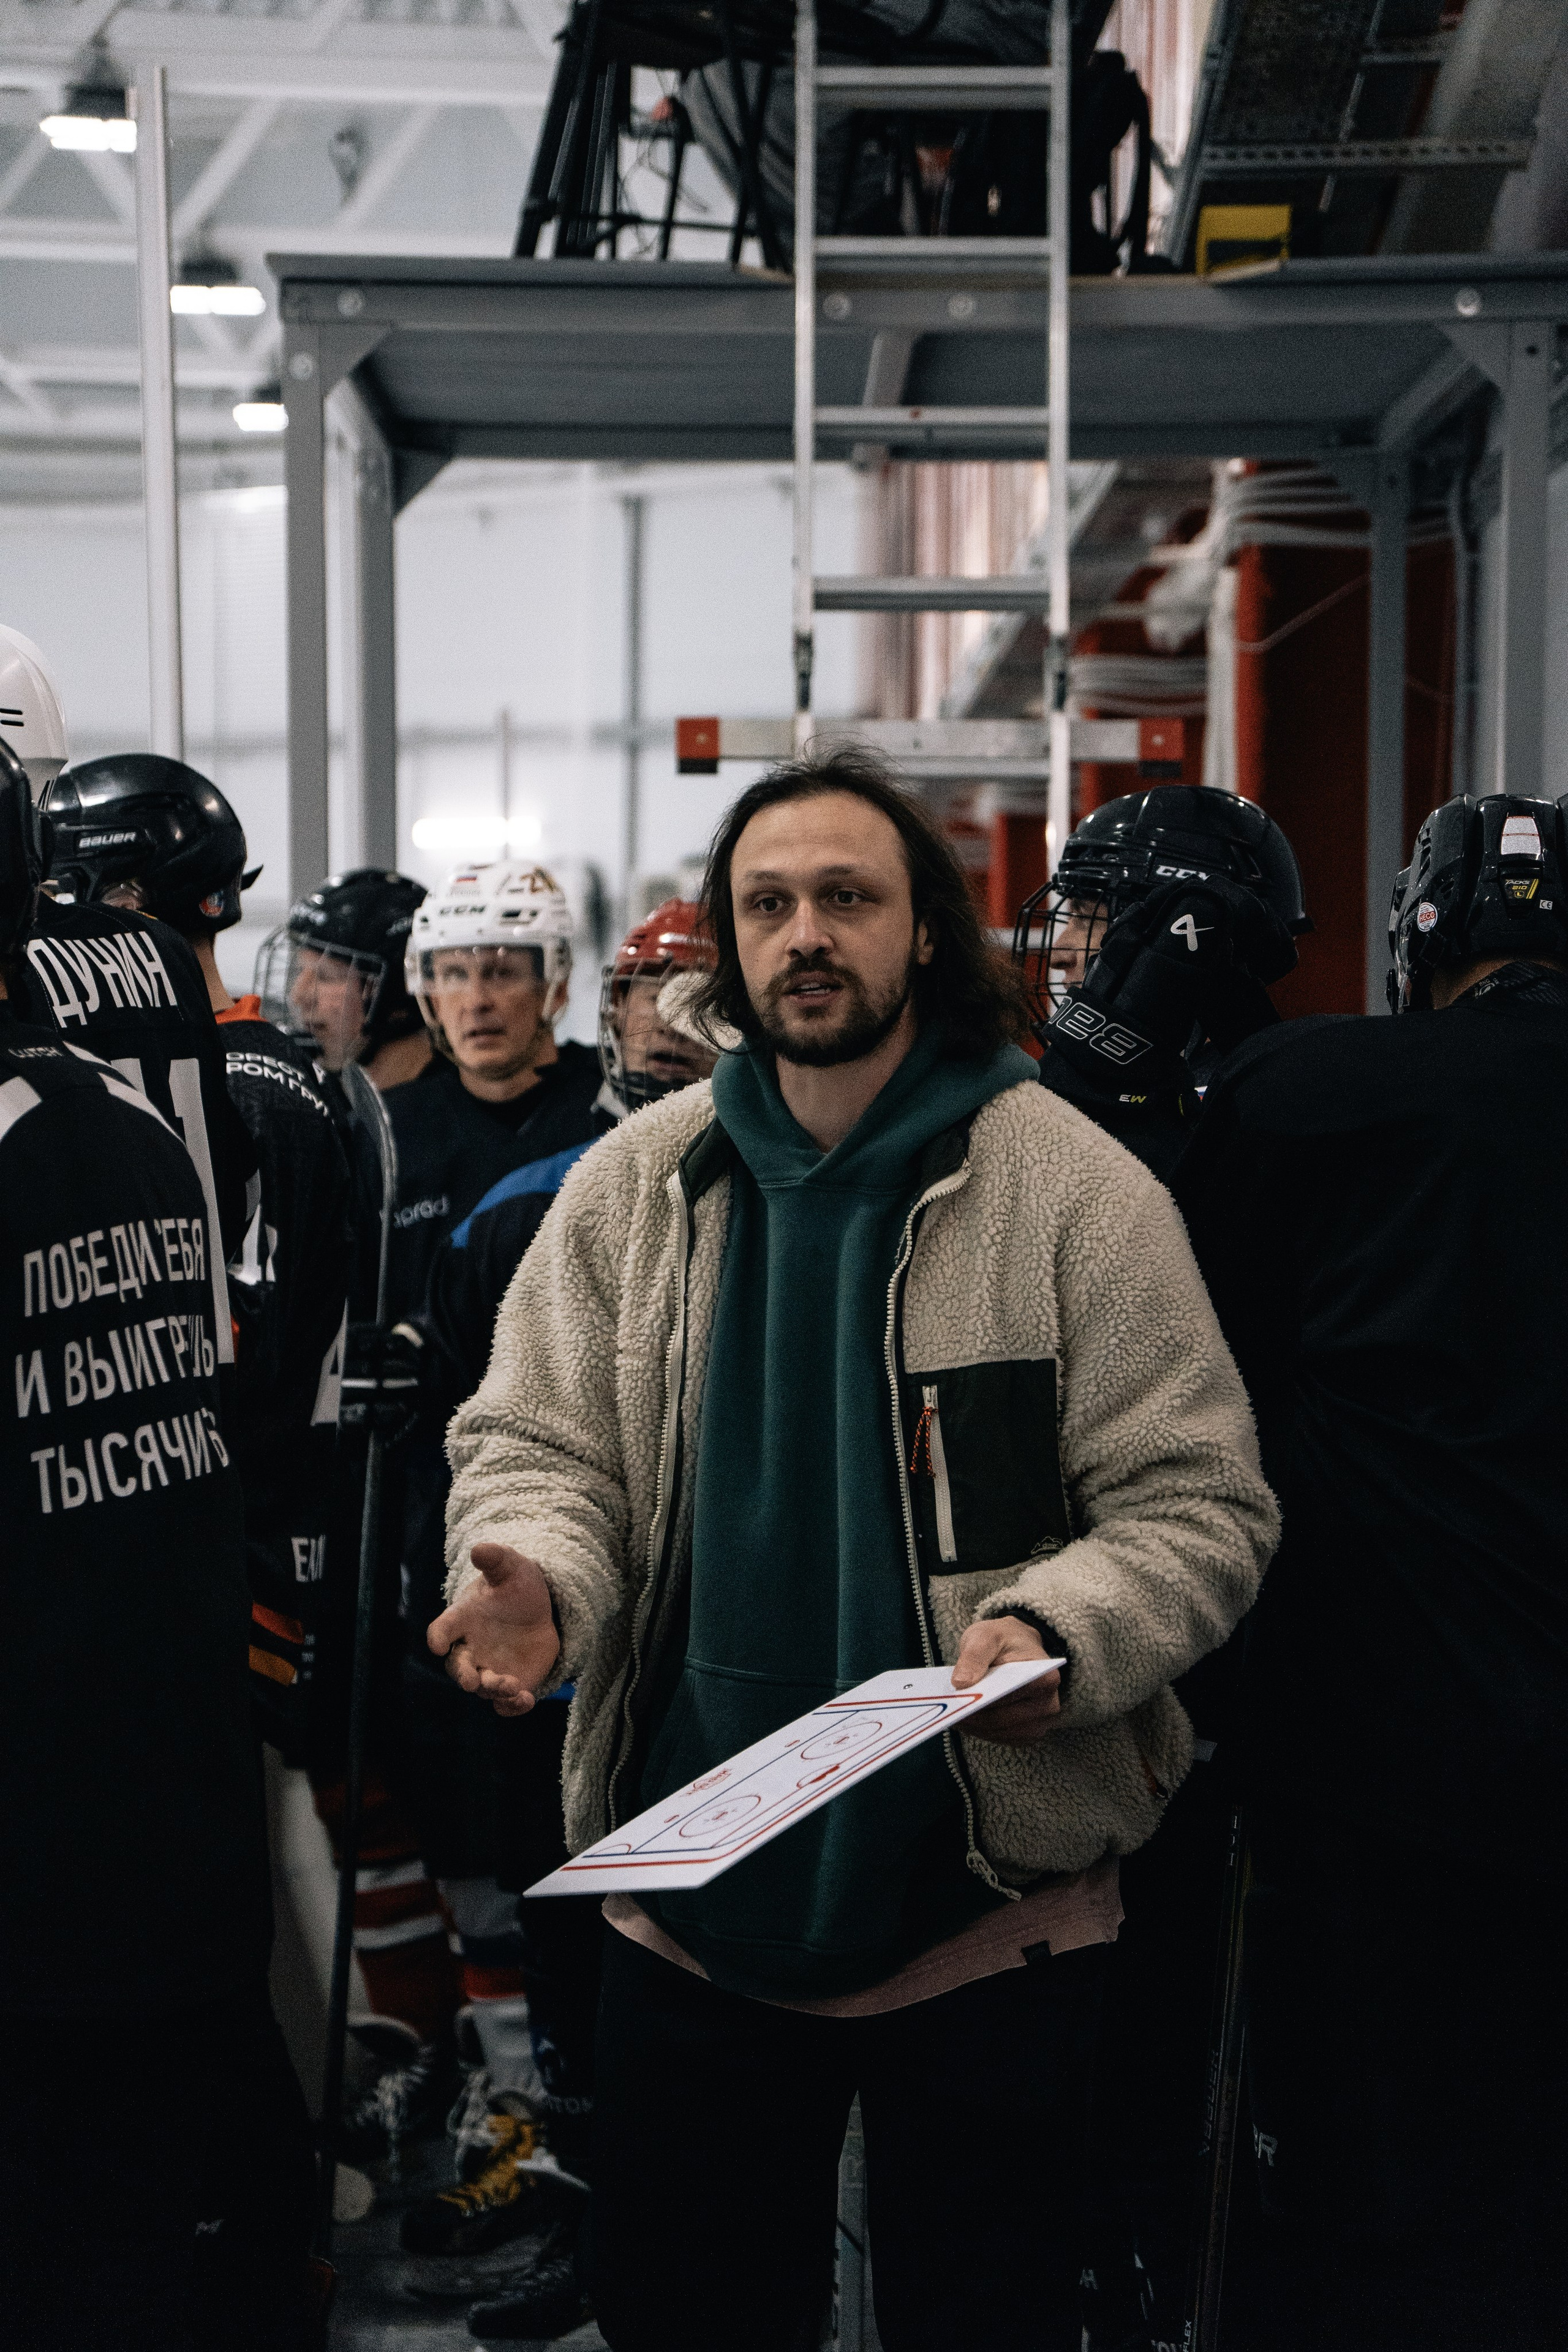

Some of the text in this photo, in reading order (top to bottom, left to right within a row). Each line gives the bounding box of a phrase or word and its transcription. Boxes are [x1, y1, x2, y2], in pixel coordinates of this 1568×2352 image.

[78, 831, 137, 848] BAUER
[27, 931, 177, 1028] ДУНИН
[23, 1218, 205, 1317] ПОБЕДИ ЕБЯ
[15, 1349, 51, 1418] И
